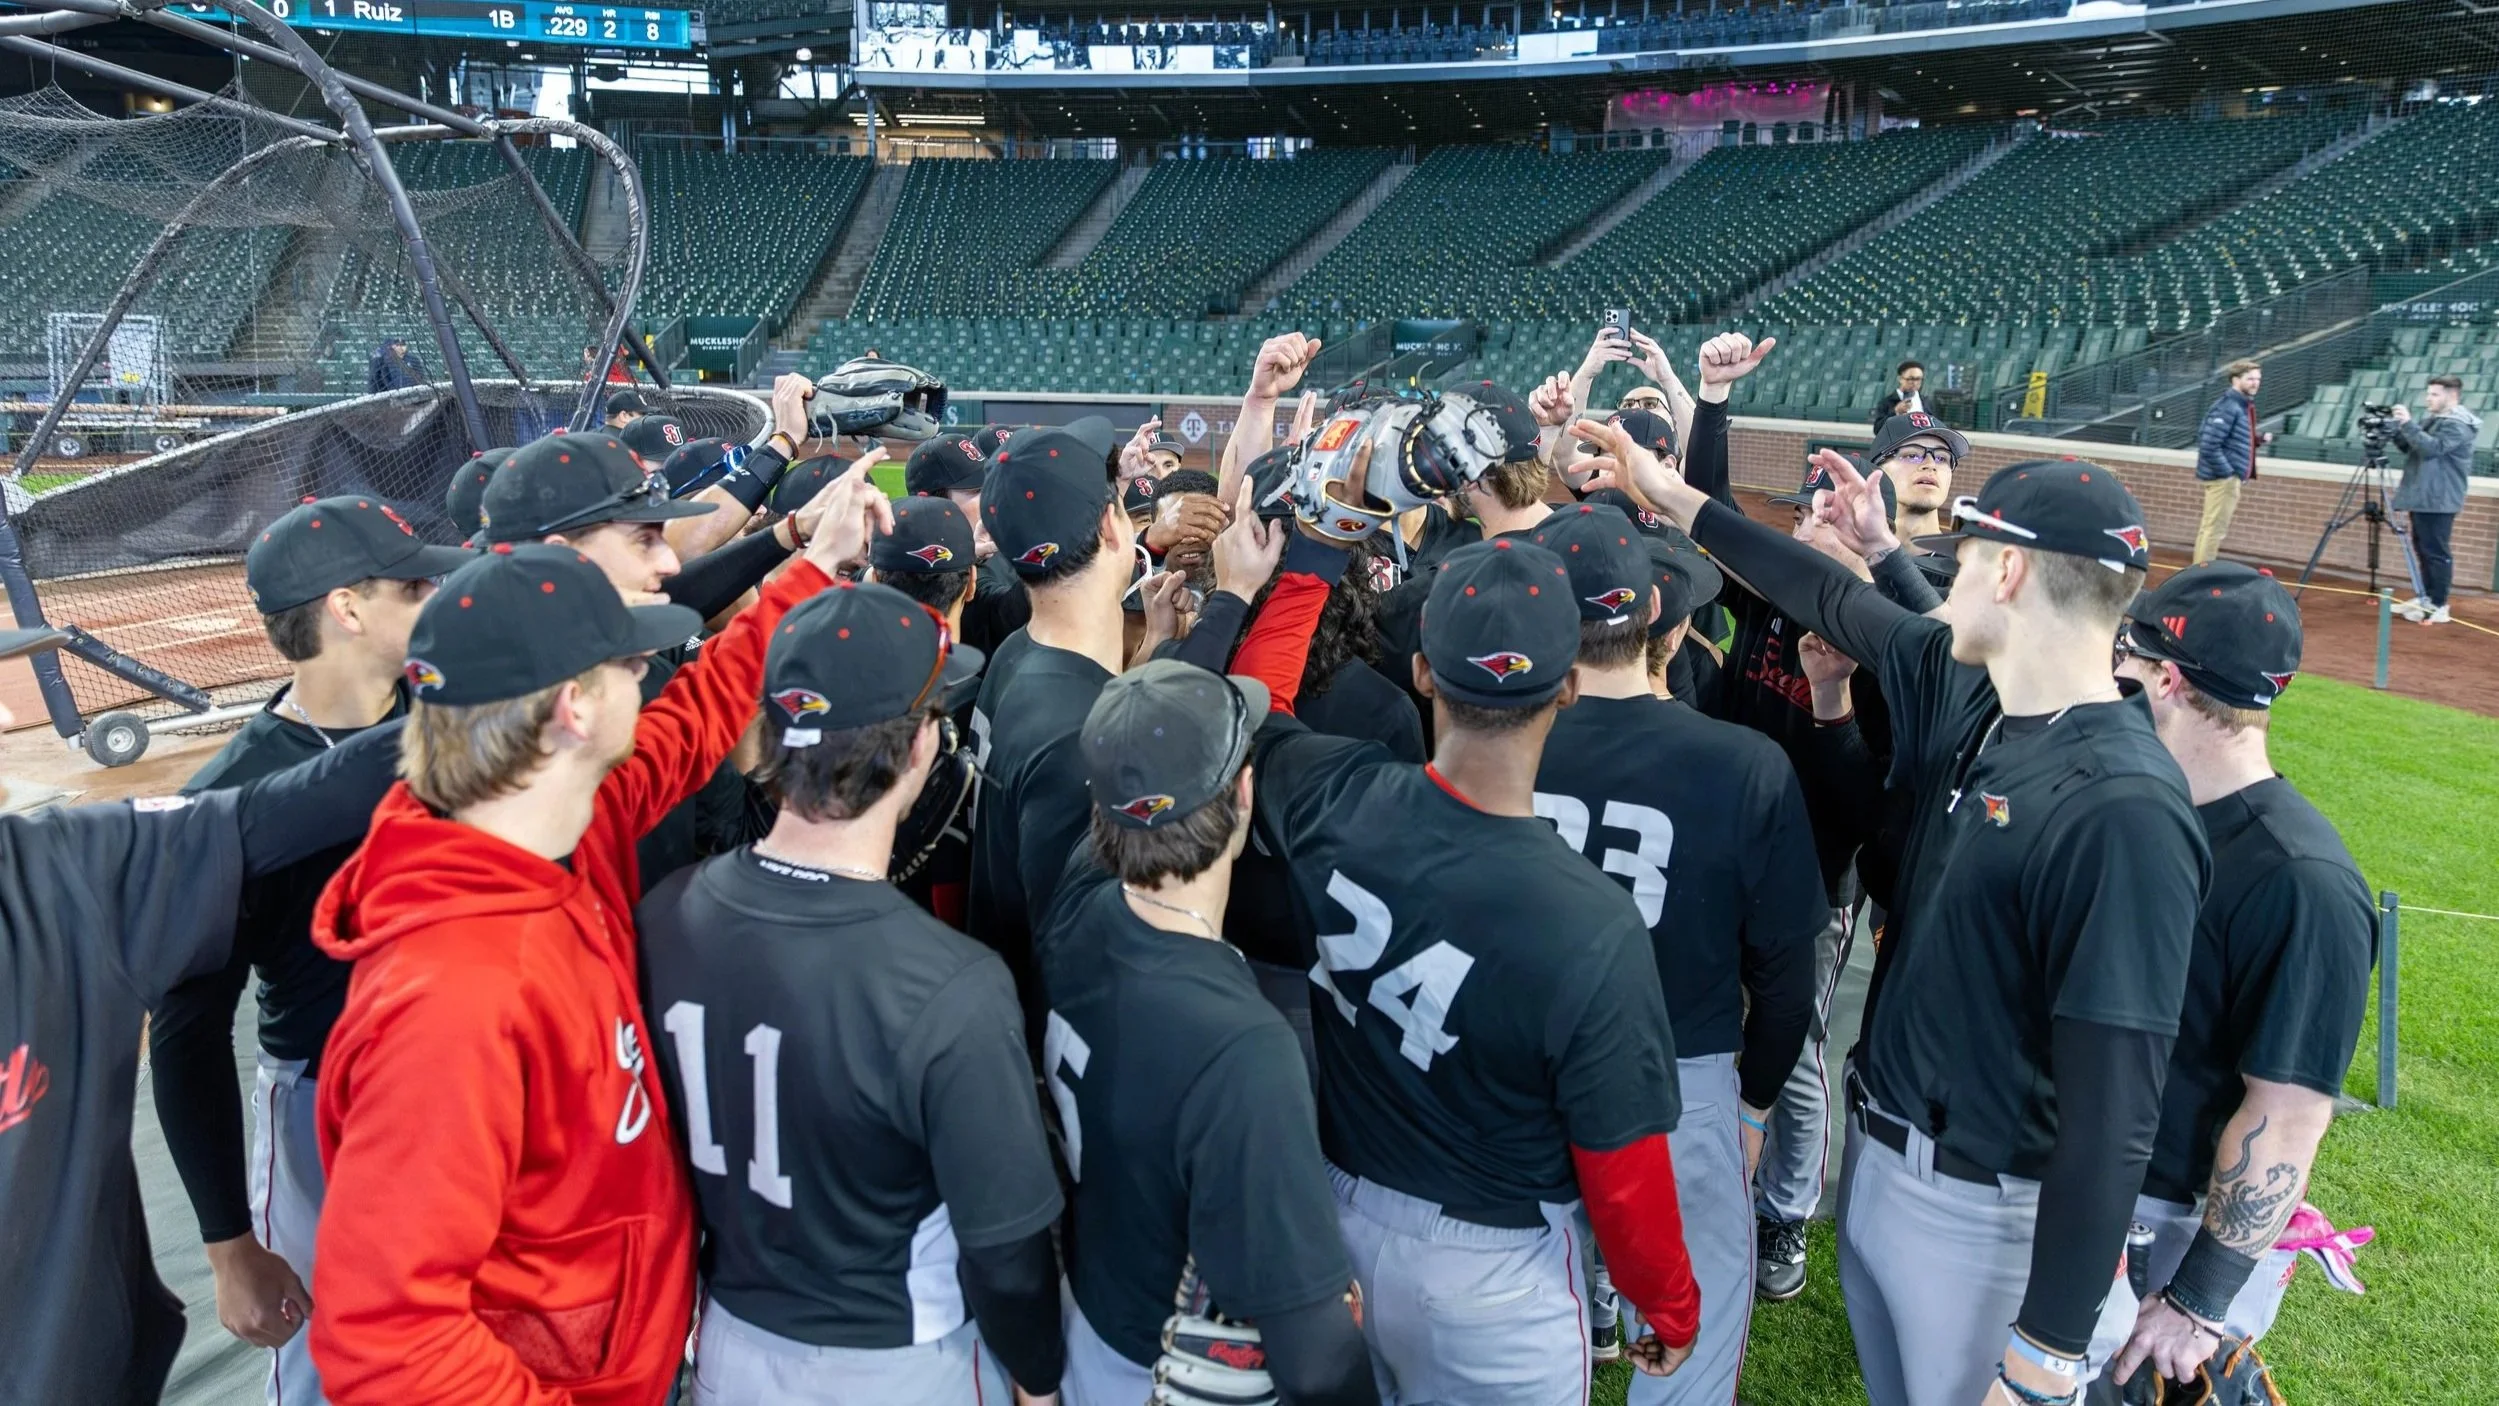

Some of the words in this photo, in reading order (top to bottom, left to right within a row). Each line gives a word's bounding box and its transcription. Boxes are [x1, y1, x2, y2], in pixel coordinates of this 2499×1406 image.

[354, 5, 403, 22] Ruiz
[488, 10, 515, 28] 1B
[555, 6, 573, 15] AVG
[603, 9, 616, 17] HR
[545, 18, 587, 37] .229
[604, 21, 616, 38] 2
[647, 23, 659, 40] 8
[1308, 868, 1475, 1073] 24
[664, 1000, 793, 1210] 11
